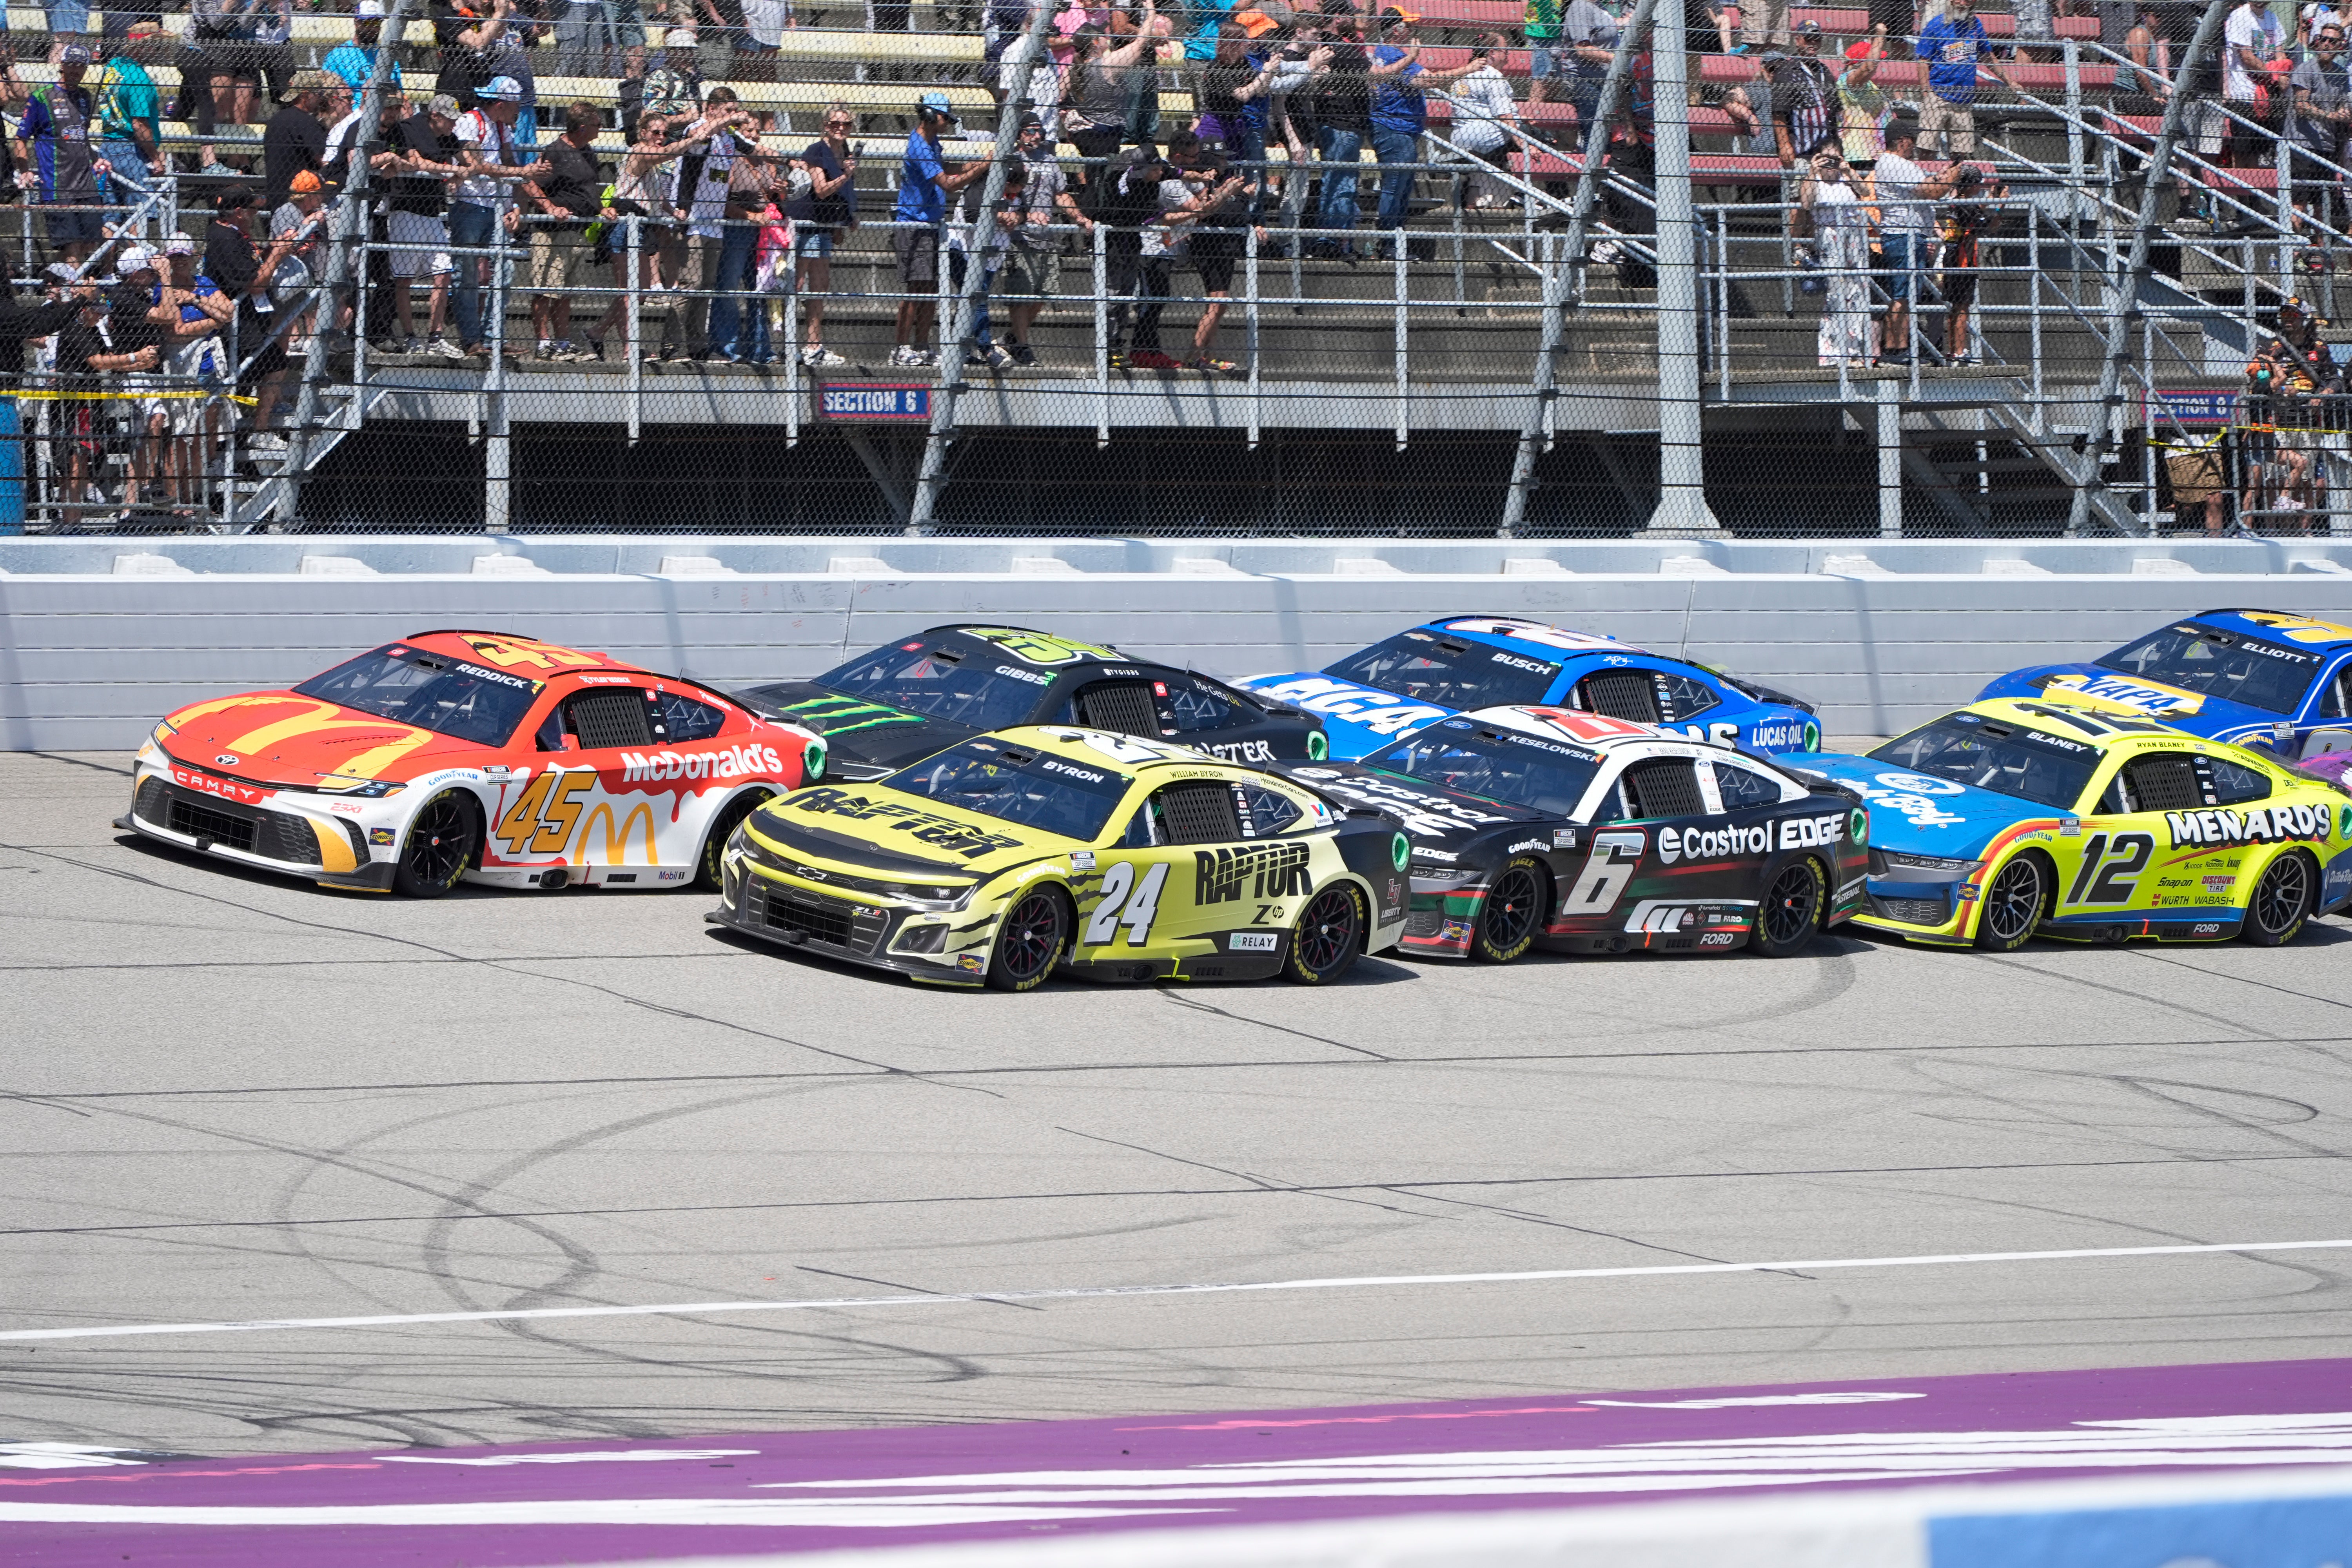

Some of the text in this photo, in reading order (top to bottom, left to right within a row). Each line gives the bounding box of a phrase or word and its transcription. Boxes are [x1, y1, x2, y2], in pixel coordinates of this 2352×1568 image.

[824, 391, 916, 412] SECTION 6
[2241, 642, 2307, 663] ELLIOTT
[1491, 653, 1552, 675] BUSCH
[455, 664, 528, 689] REDDICK
[995, 666, 1046, 685] GIBBS
[1193, 679, 1208, 693] He
[1208, 685, 1229, 701] Gets
[2062, 677, 2184, 710] NAPA
[1753, 726, 1787, 747] LUCAS
[1788, 724, 1802, 745] OIL
[2026, 731, 2088, 752] BLANEY
[1194, 740, 1278, 763] STER
[1508, 735, 1596, 762] KESELOWSKI
[620, 743, 783, 782] McDonald's
[1042, 761, 1104, 783] BYRON
[2240, 755, 2270, 772] ADVANCE
[177, 771, 255, 799] CAMRY
[428, 770, 478, 786] GOODYEAR
[1336, 777, 1511, 823] Castrol
[496, 771, 599, 854] 45
[779, 788, 1024, 859] RAPTOR
[2165, 804, 2331, 850] MENARDS
[1508, 838, 1551, 854] GOODYEAR
[1684, 820, 1773, 859] Castrol
[1780, 813, 1845, 850] EDGE
[2014, 829, 2053, 843] GOODYEAR
[1412, 846, 1459, 861] EDGE
[1510, 858, 1535, 868] EAGLE
[446, 853, 469, 889] EAGLE
[659, 871, 677, 880] Mobil
[1017, 864, 1065, 883] GOODYEAR
[1194, 842, 1312, 906] RAPTOR
[1563, 833, 1645, 915] 6
[2062, 831, 2156, 907] 12
[2157, 877, 2193, 888] Snap-on
[2201, 875, 2236, 885] DISCOUNT
[1807, 857, 1825, 925] GOODYEAR
[1959, 888, 1979, 897] SUNOCO
[2195, 896, 2234, 905] WABASH
[852, 906, 882, 916] ZL1
[1083, 861, 1171, 947] 24
[1350, 887, 1363, 920] EAGLE
[1381, 906, 1402, 918] LIBERTY
[1250, 905, 1273, 924] Z
[1380, 916, 1400, 924] UNIVERSITY
[1444, 926, 1468, 936] SUNOCO
[1700, 933, 1733, 944] FORD
[2193, 924, 2220, 933] FORD
[1241, 936, 1274, 947] RELAY
[1294, 921, 1318, 982] GOODYEAR
[1483, 936, 1531, 960] GOODYEAR
[958, 960, 983, 969] SUNOCO
[1016, 936, 1065, 990] GOODYEAR
